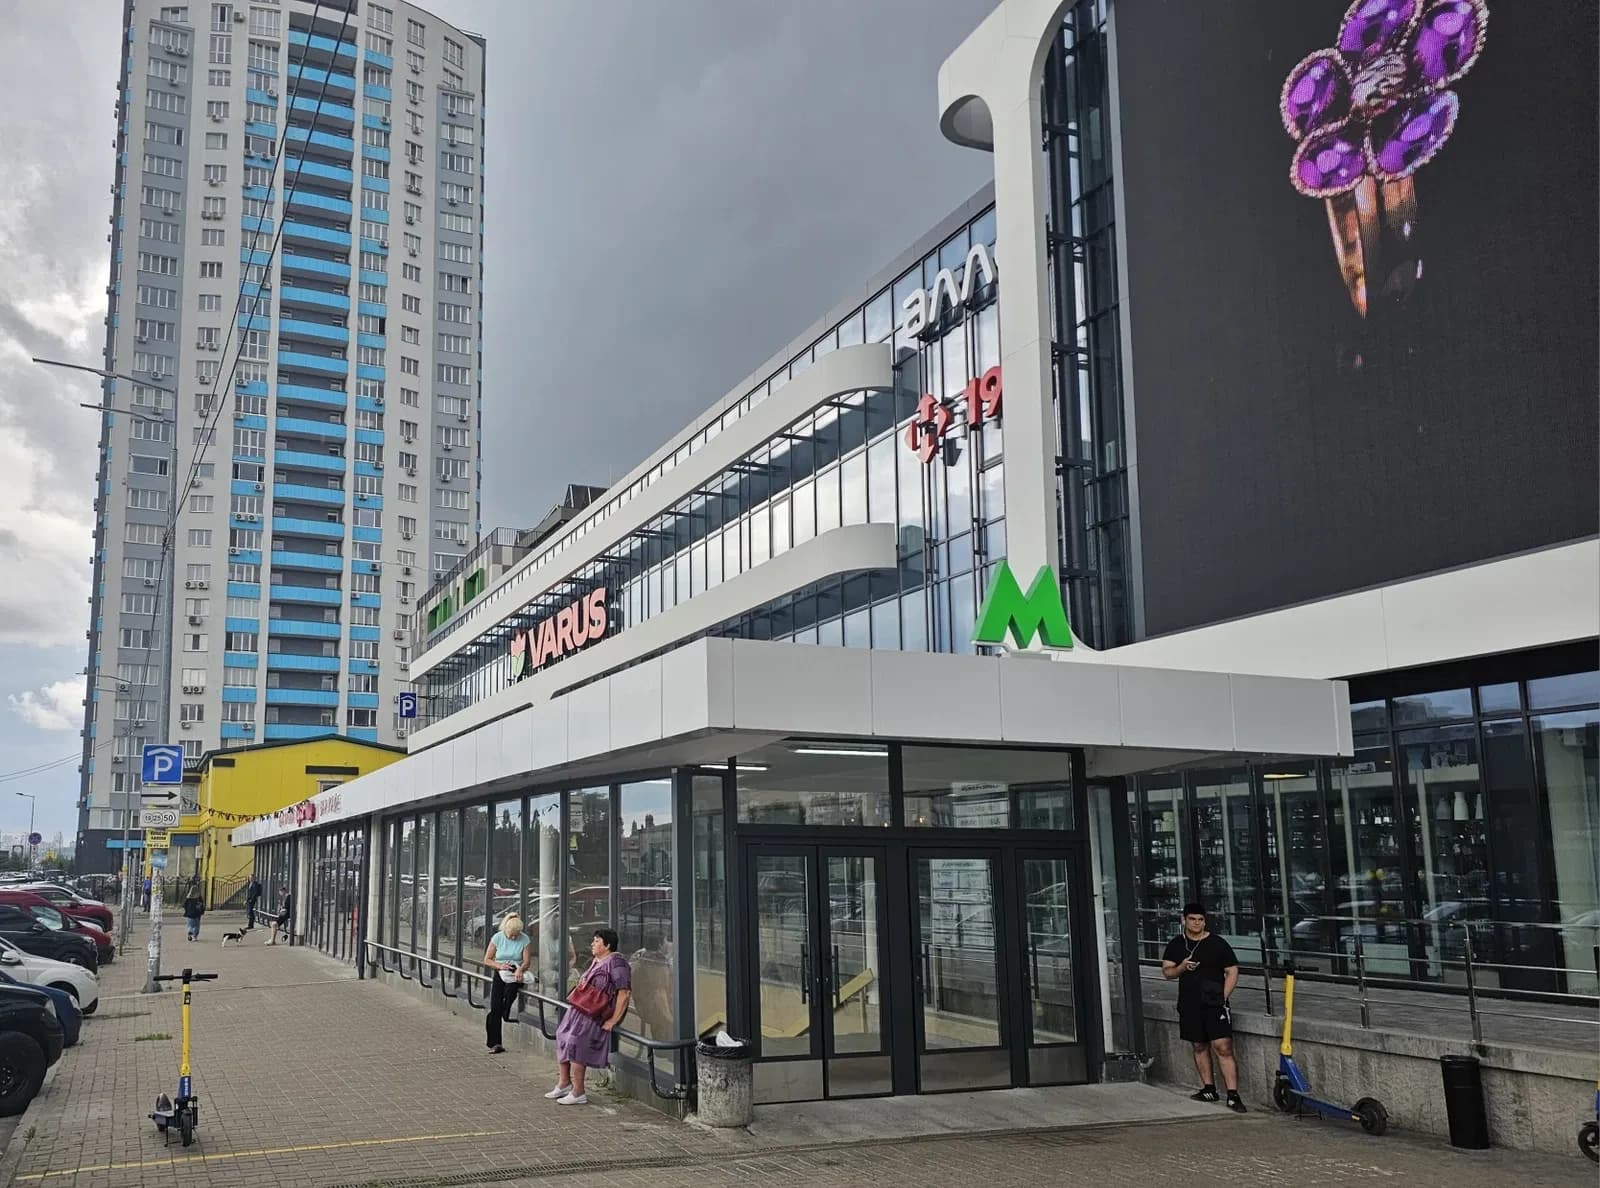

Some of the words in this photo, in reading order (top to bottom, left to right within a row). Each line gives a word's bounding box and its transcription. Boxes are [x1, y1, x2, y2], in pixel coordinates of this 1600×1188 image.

[903, 244, 998, 338] алл
[964, 366, 1002, 425] 19
[528, 587, 606, 668] VARUS
[402, 700, 413, 716] P
[154, 755, 172, 780] P
[163, 814, 174, 822] 50
